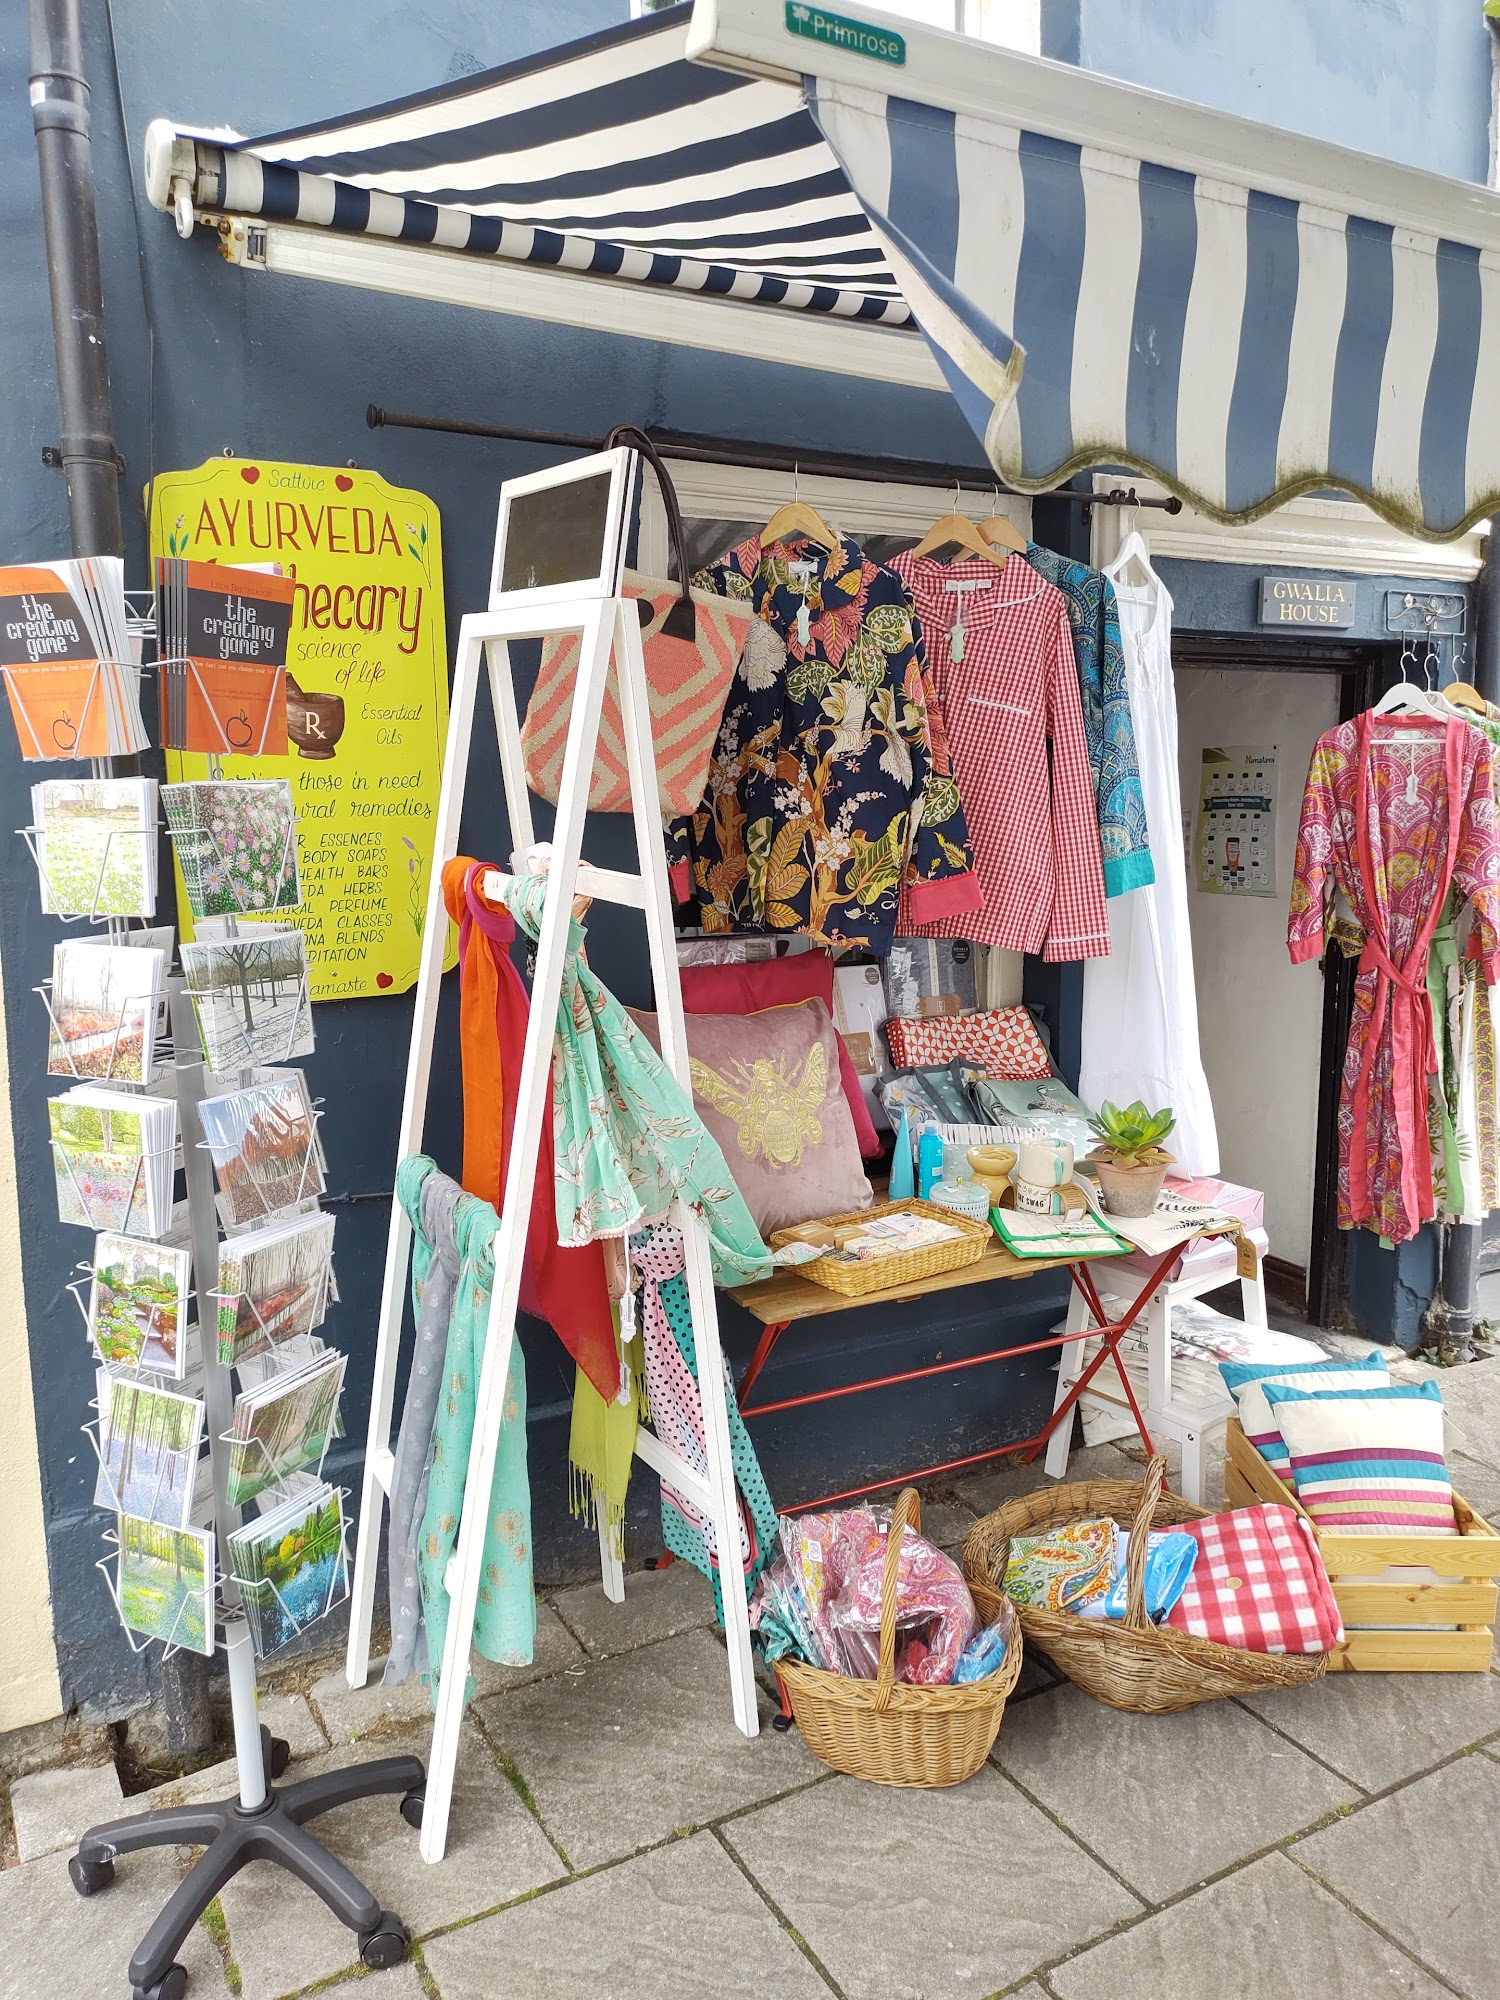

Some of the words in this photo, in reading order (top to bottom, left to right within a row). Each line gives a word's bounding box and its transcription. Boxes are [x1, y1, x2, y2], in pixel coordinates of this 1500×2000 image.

[813, 14, 899, 59] Primrose
[267, 468, 326, 491] Sattvic
[194, 497, 403, 557] AYURVEDA
[1272, 581, 1346, 603] GWALIA
[21, 594, 56, 621] the
[224, 594, 257, 624] the
[287, 563, 423, 655] hecary
[1279, 603, 1340, 623] HOUSE
[5, 618, 81, 643] creating
[202, 617, 275, 649] creating
[26, 636, 69, 662] game
[219, 636, 260, 660] game
[296, 636, 363, 661] science
[335, 661, 358, 692] of
[355, 660, 386, 694] life
[361, 703, 422, 722] Essential
[376, 728, 403, 745] Oils
[299, 771, 344, 792] those
[352, 771, 370, 790] in
[378, 769, 423, 790] need
[350, 800, 433, 819] remedies
[320, 832, 382, 848] ESSENCES
[302, 850, 337, 864] BODY
[347, 848, 388, 863] SOAPS
[299, 866, 345, 881] HEALTH
[357, 864, 389, 880] BARS
[343, 881, 383, 896] HERBS
[329, 897, 389, 913] PERFUME
[337, 913, 393, 929] CLASSES
[336, 929, 386, 945] BLENDS
[309, 976, 368, 996] amaste
[1026, 1197, 1044, 1208] SWAG
